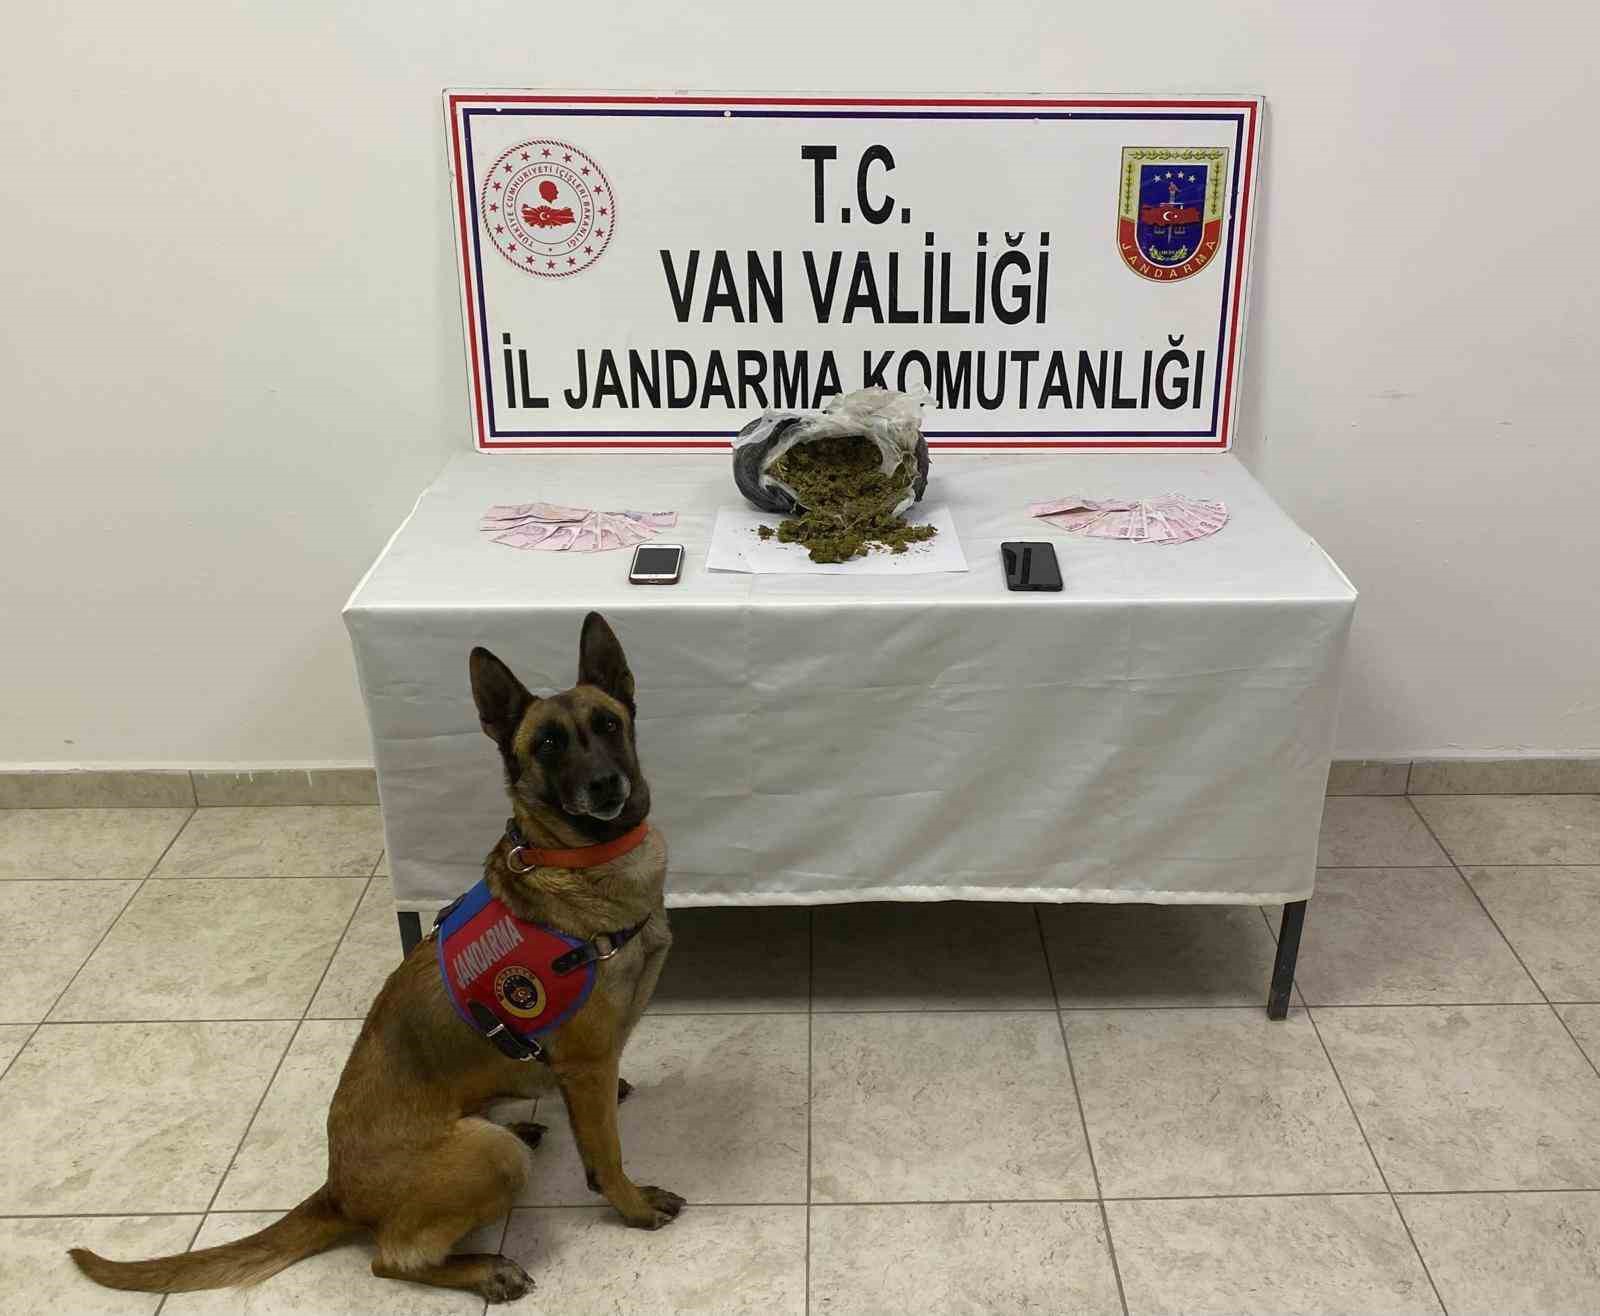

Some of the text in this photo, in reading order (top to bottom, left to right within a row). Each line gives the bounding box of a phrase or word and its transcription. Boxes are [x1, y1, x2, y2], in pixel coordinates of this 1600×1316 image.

[802, 145, 911, 224] T.C.
[660, 232, 1050, 325] VAN VALİLİĞİ
[1121, 240, 1216, 279] JANDARMA
[503, 333, 1206, 410] İL JANDARMA KOMUTANLIĞI
[453, 914, 524, 989] JANDARMA
